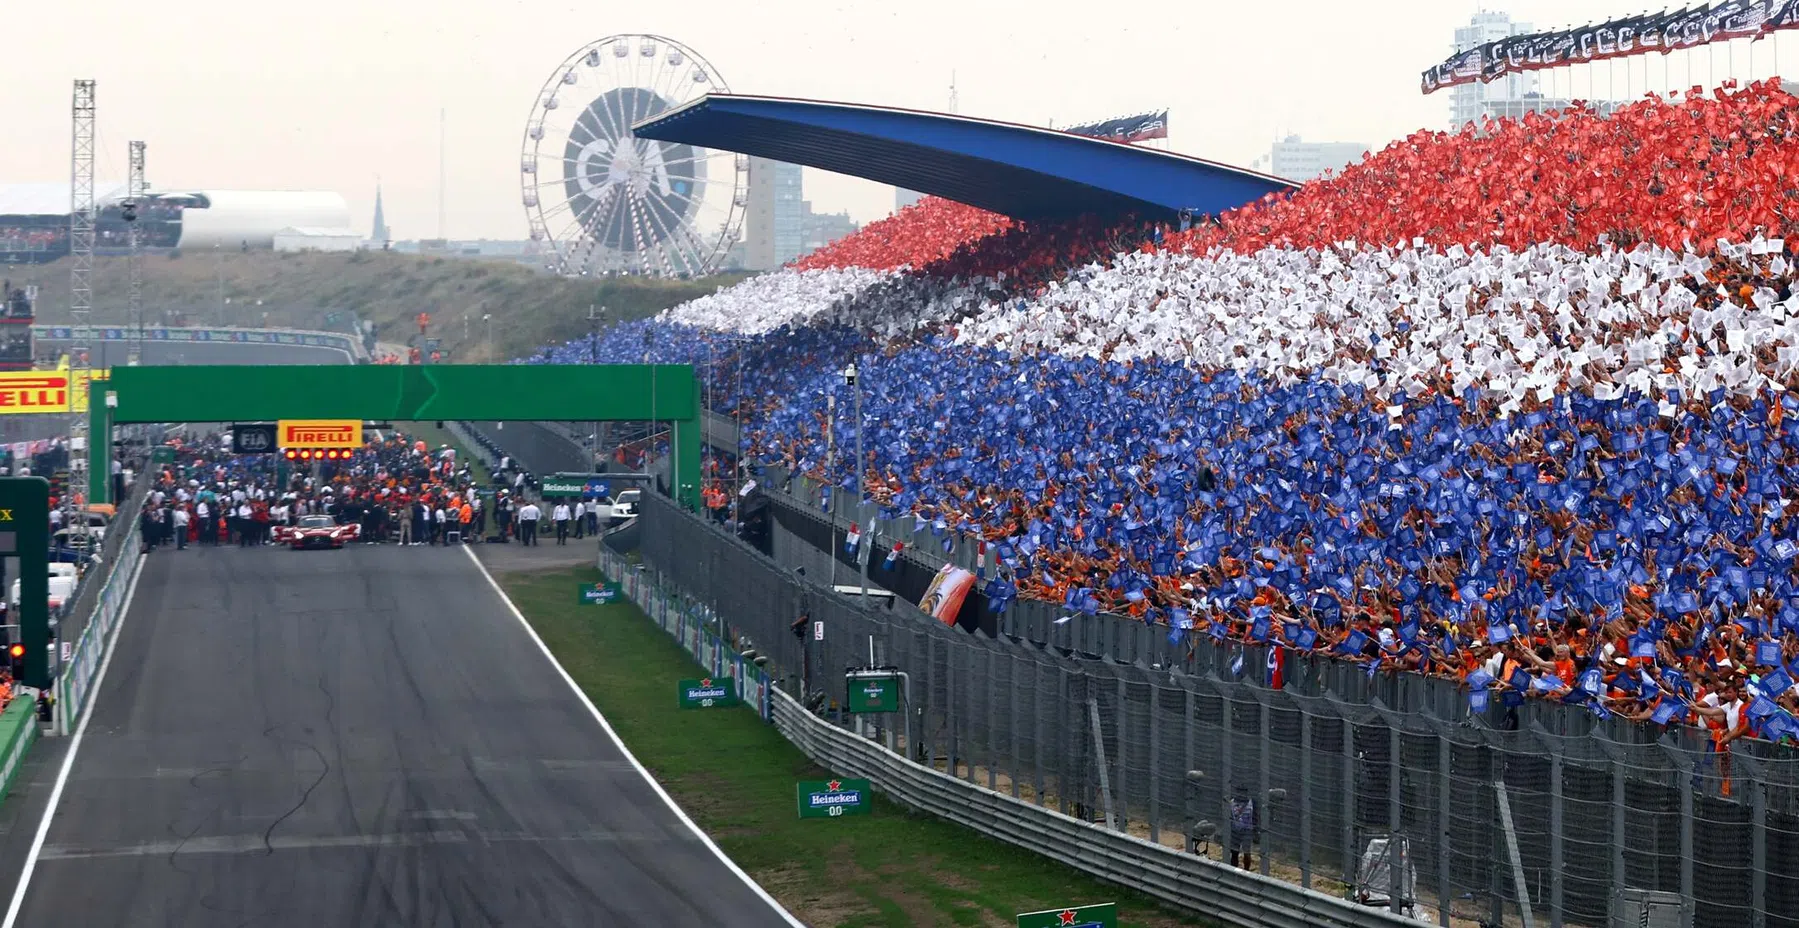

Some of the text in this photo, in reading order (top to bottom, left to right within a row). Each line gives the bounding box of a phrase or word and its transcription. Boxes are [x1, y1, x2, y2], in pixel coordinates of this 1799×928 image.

[241, 433, 269, 446] FIA
[287, 426, 353, 442] PIRELLI
[543, 483, 582, 492] Heineken
[688, 690, 725, 698] Heineken
[811, 793, 858, 804] Heineken
